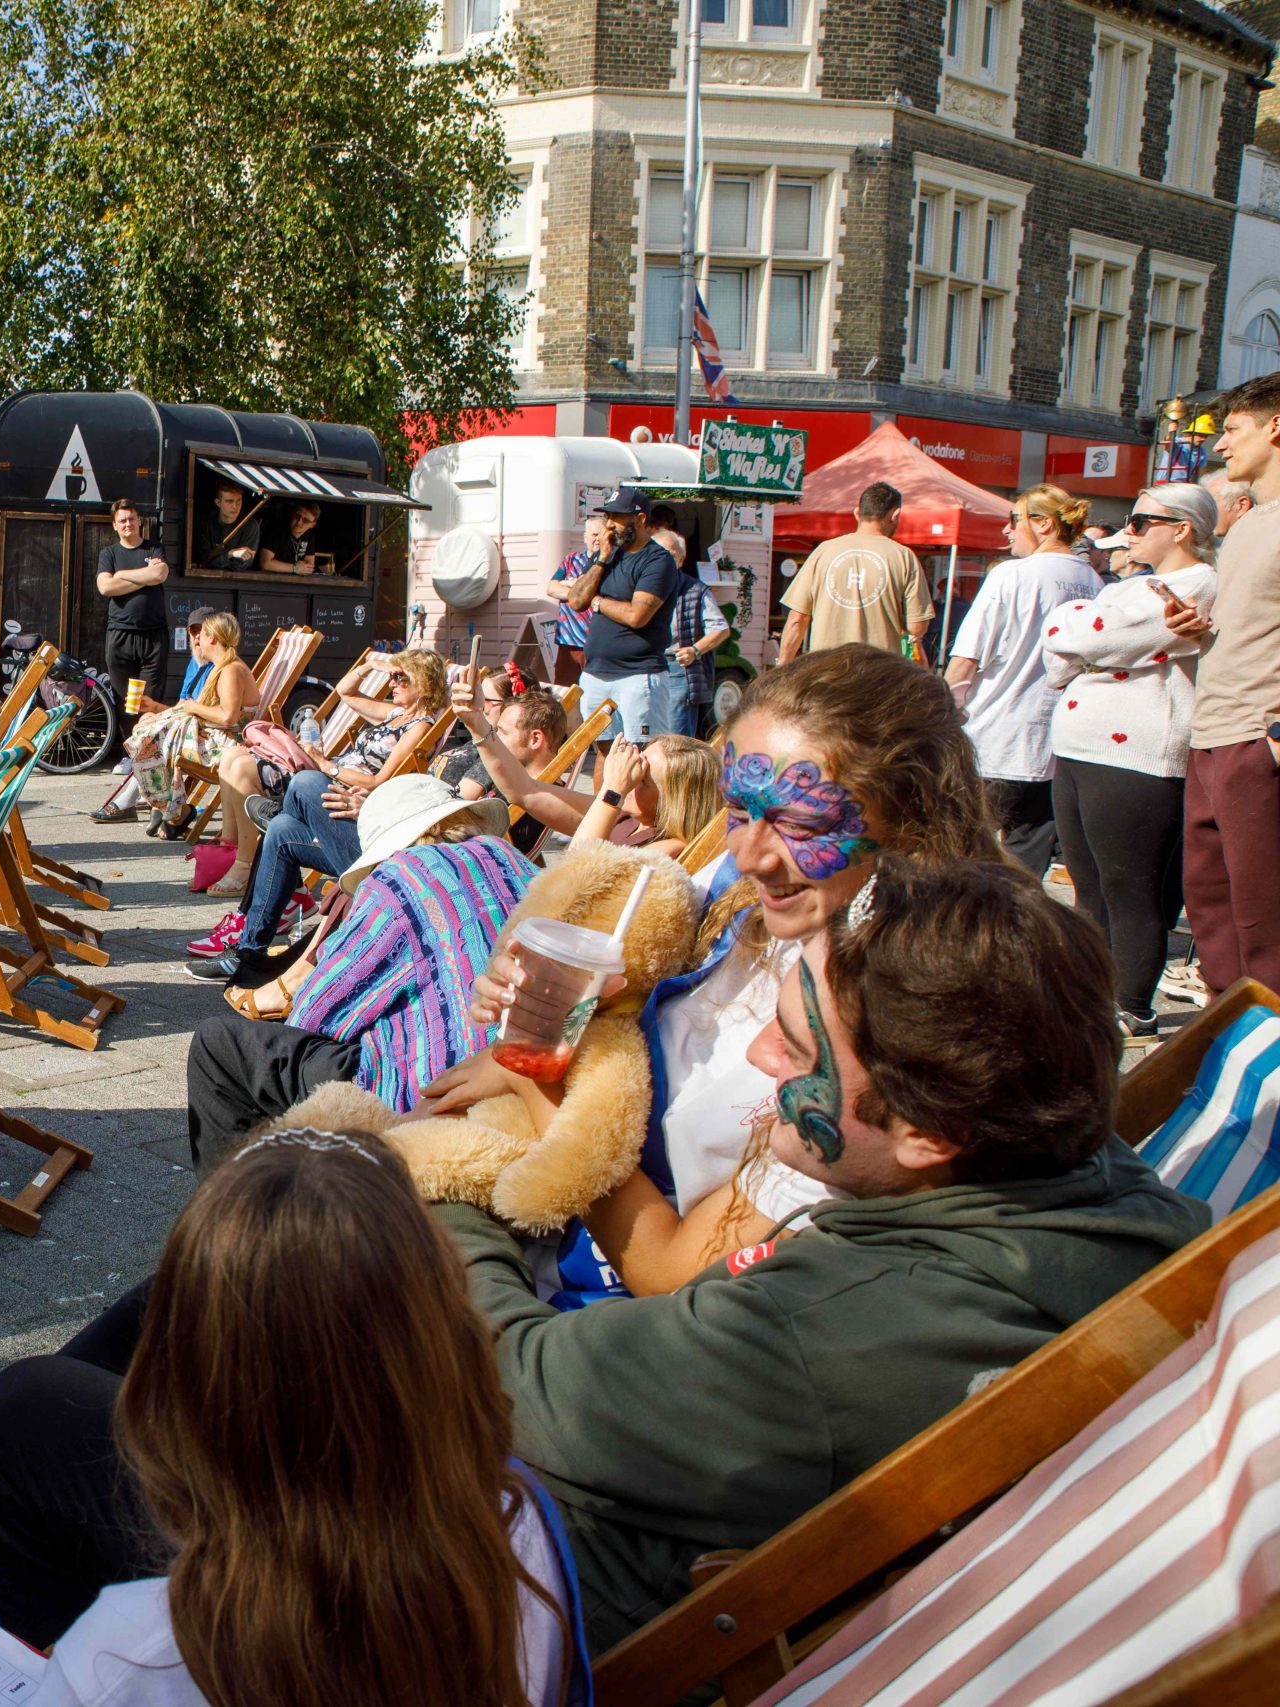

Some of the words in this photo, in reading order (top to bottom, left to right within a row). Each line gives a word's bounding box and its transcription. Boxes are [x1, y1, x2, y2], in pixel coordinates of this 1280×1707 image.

[720, 427, 766, 454] Shakes
[922, 441, 966, 461] vodafone
[727, 453, 781, 484] Waffles
[1091, 450, 1109, 473] 3
